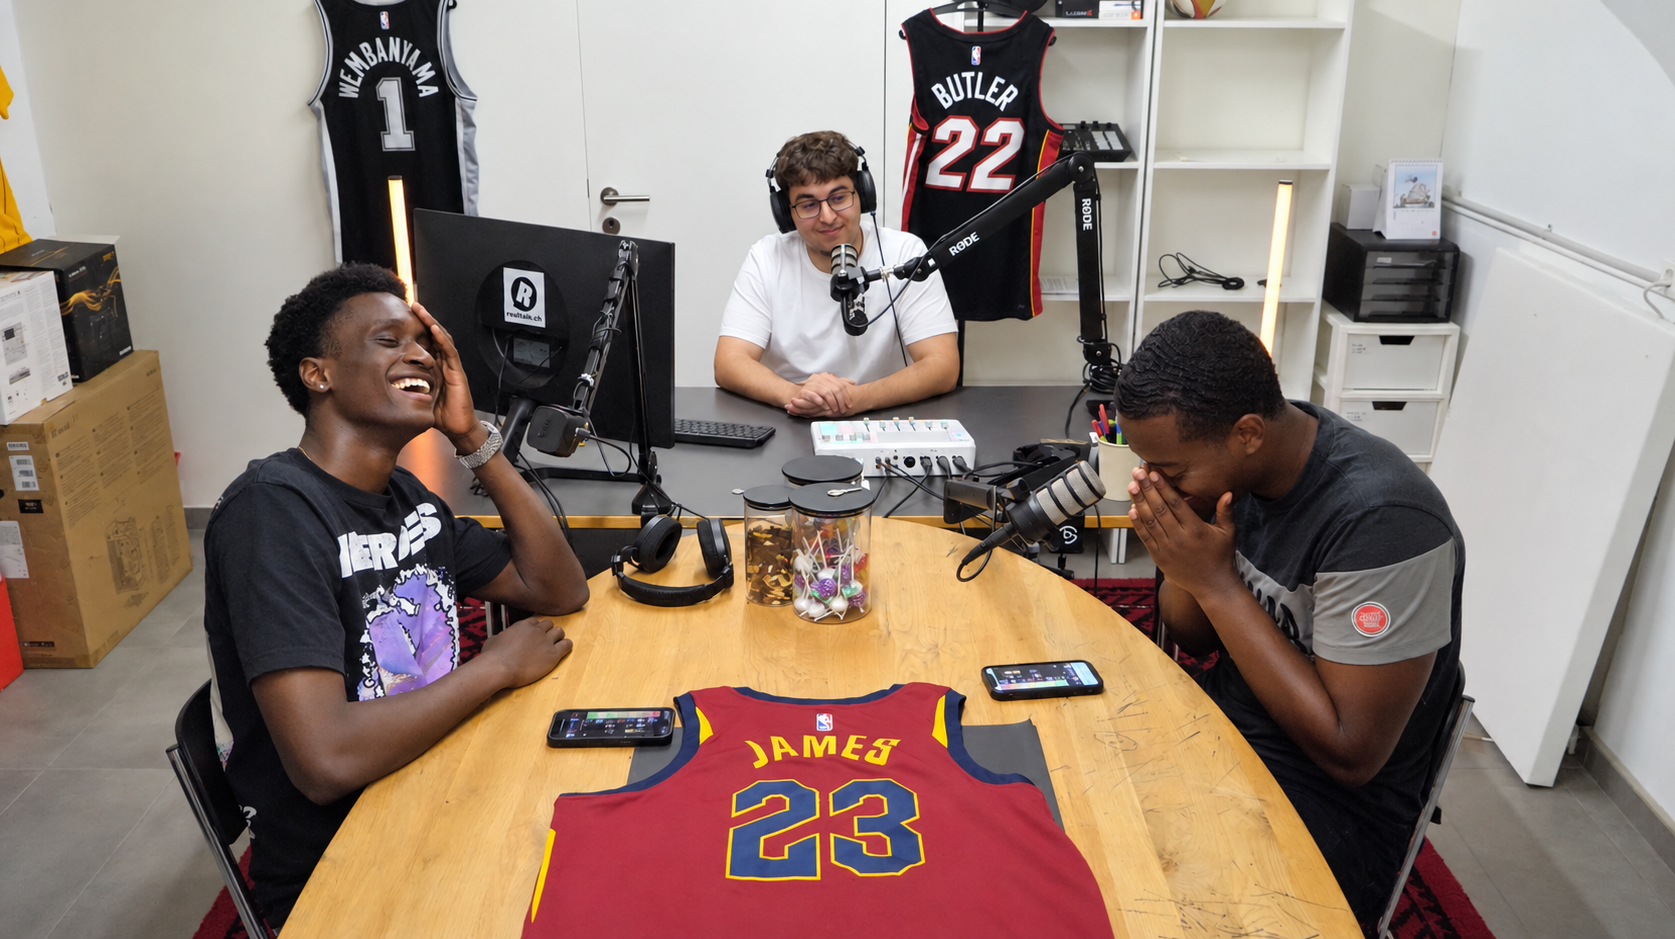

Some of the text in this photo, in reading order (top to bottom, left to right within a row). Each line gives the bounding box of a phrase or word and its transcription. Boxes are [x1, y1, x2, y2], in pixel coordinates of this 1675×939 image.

[338, 36, 439, 98] WEMBANYAMA
[930, 71, 1019, 112] BUTLER
[375, 77, 416, 152] 1
[924, 115, 1026, 194] 22
[744, 735, 900, 769] JAMES
[725, 778, 926, 882] 23
